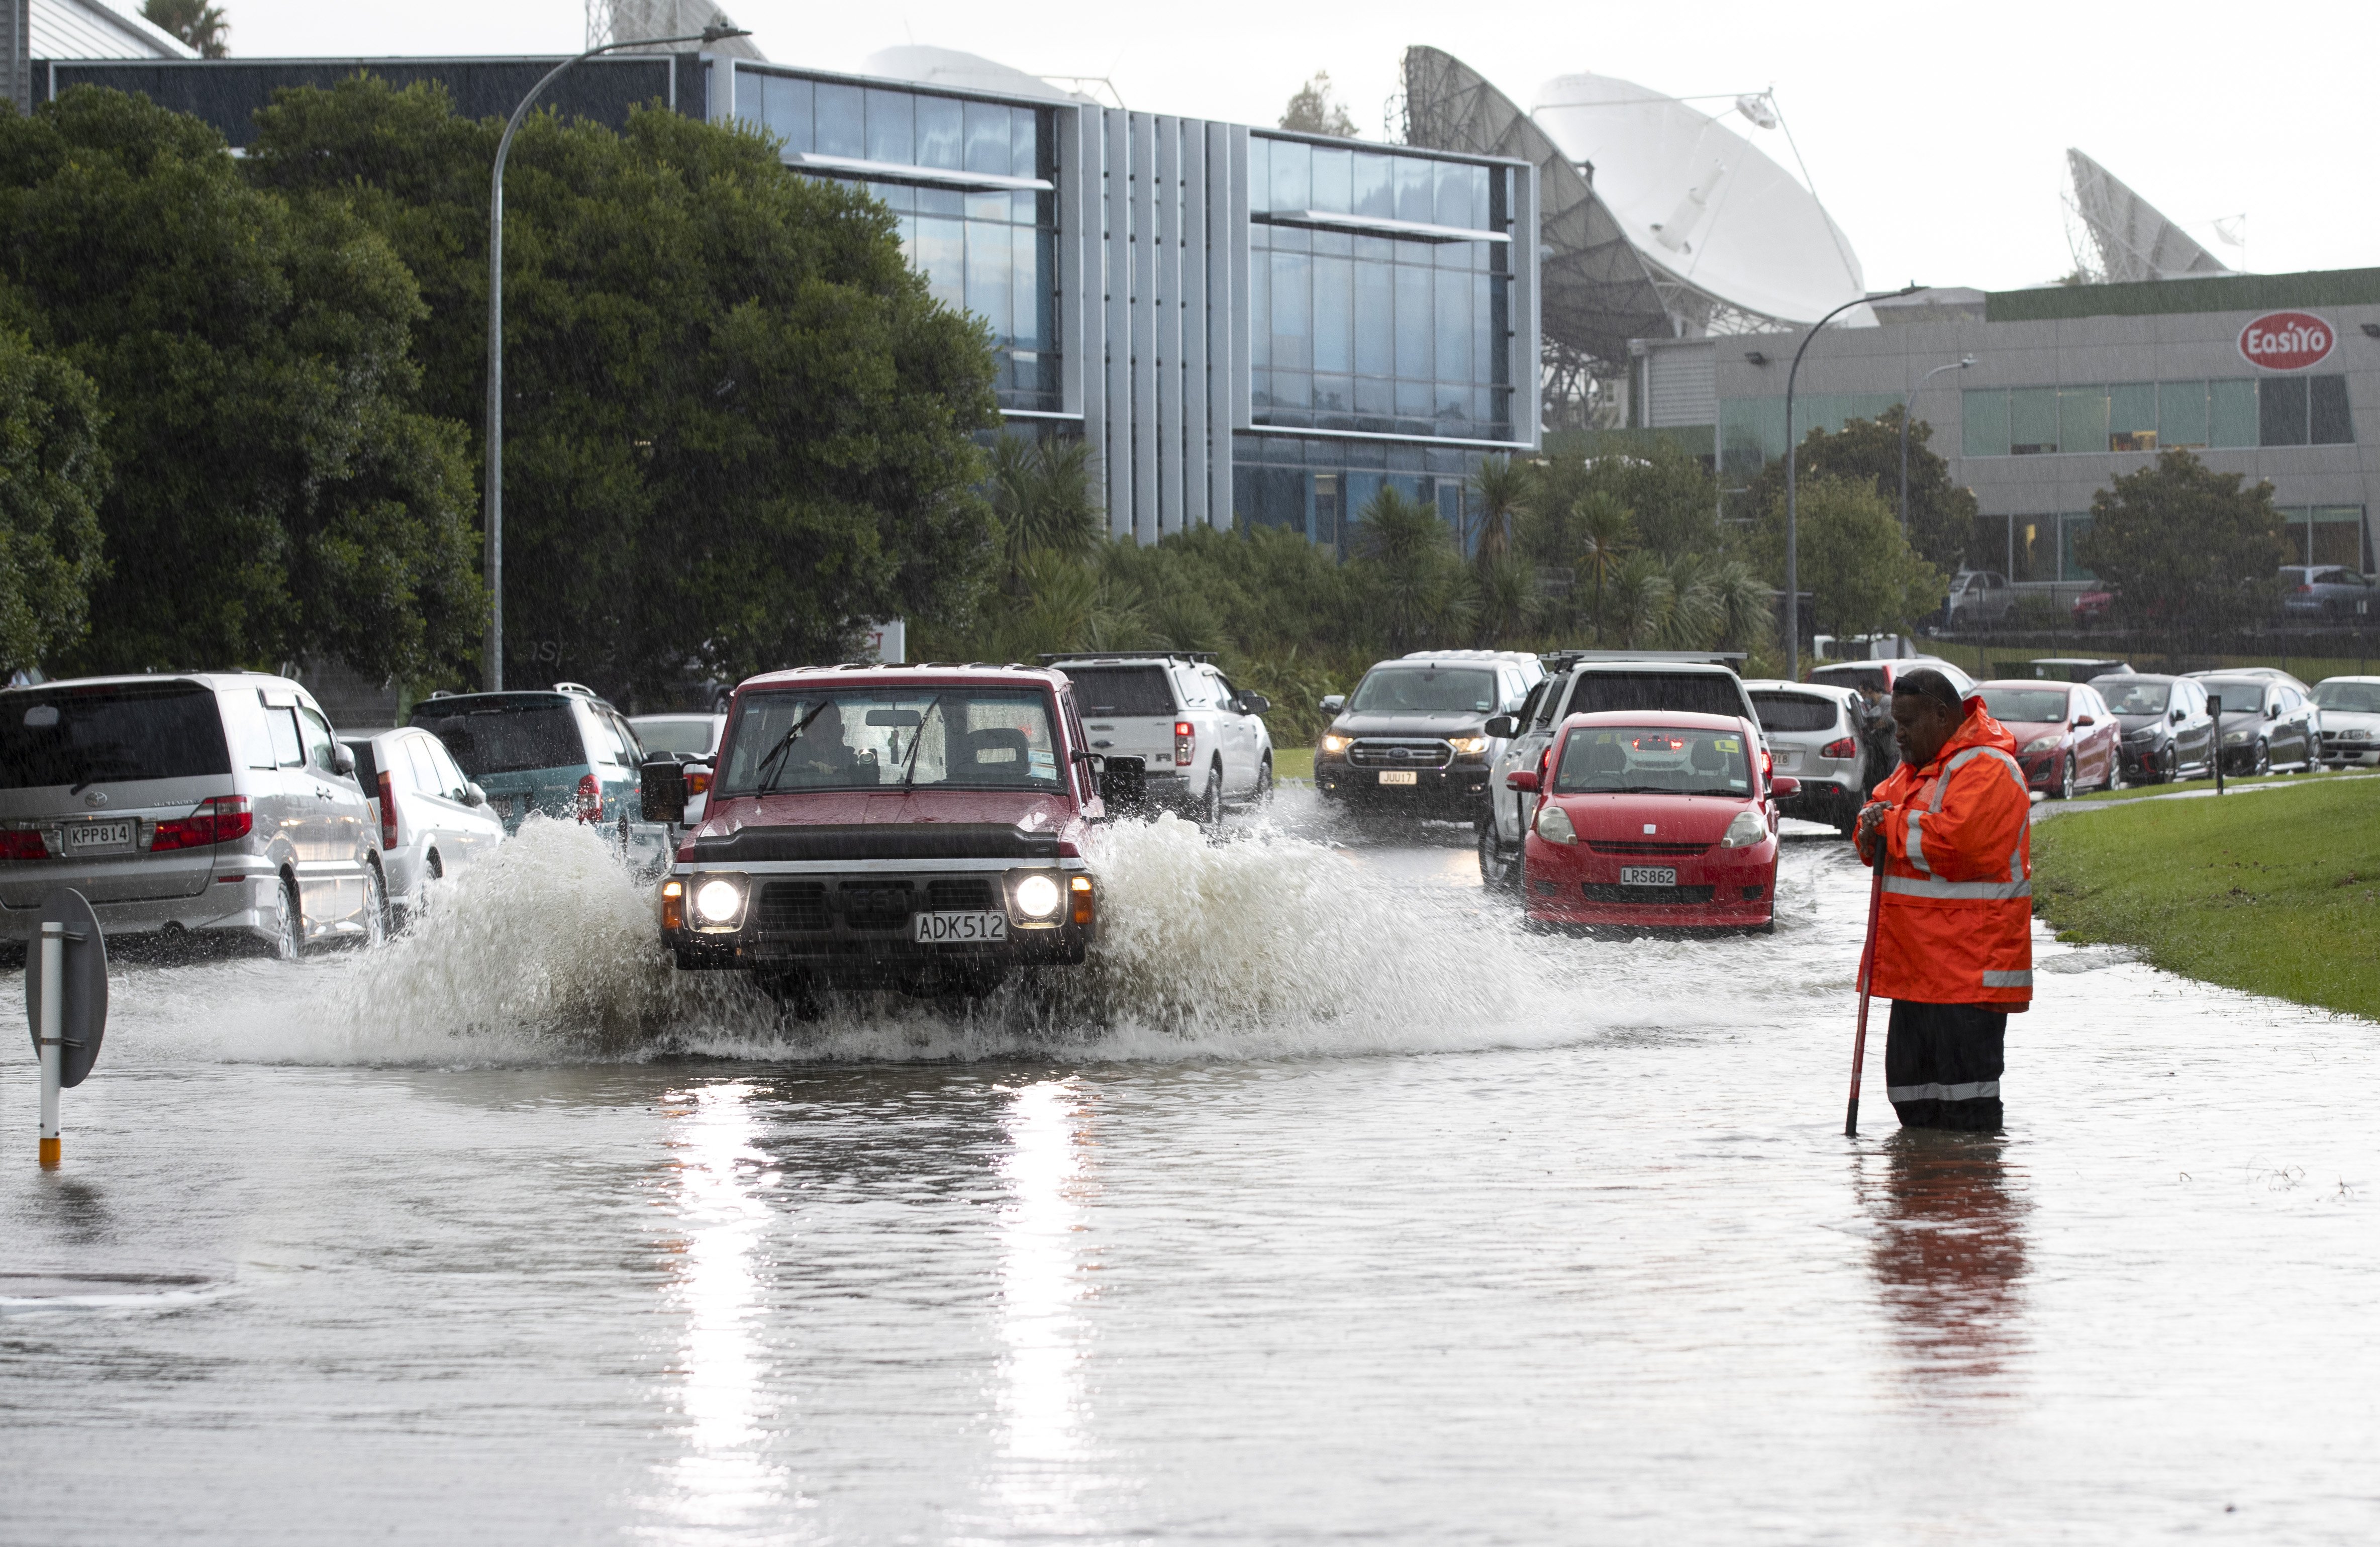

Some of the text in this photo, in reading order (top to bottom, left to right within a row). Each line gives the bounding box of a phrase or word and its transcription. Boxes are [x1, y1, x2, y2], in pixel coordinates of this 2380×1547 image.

[1384, 774, 1411, 782] JUU17
[72, 826, 127, 843] KPP814
[1623, 869, 1674, 883] LRS862
[919, 915, 1004, 939] ADK512
